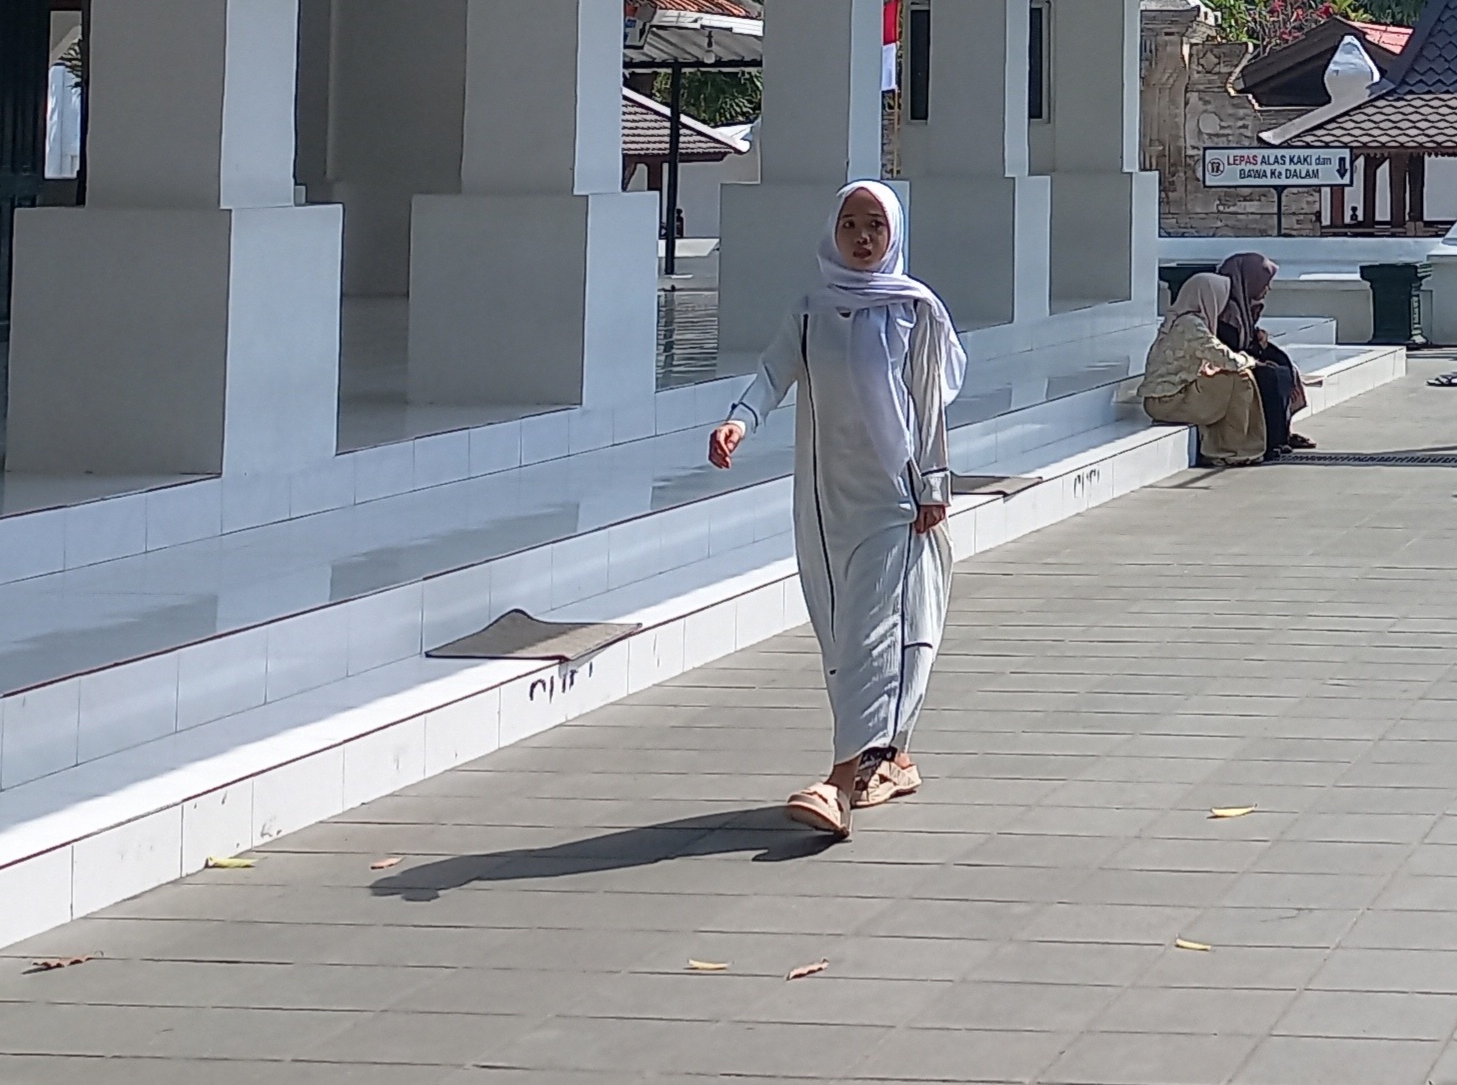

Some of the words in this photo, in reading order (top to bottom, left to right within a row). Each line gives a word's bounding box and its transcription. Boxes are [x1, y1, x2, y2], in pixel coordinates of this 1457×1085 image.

[1227, 155, 1258, 166] LEPAS
[1260, 155, 1287, 166] ALAS
[1289, 155, 1313, 165] KAKI
[1315, 155, 1332, 165] dan
[1239, 169, 1268, 179] BAWA
[1270, 168, 1282, 179] Ke
[1285, 168, 1320, 179] DALAM
